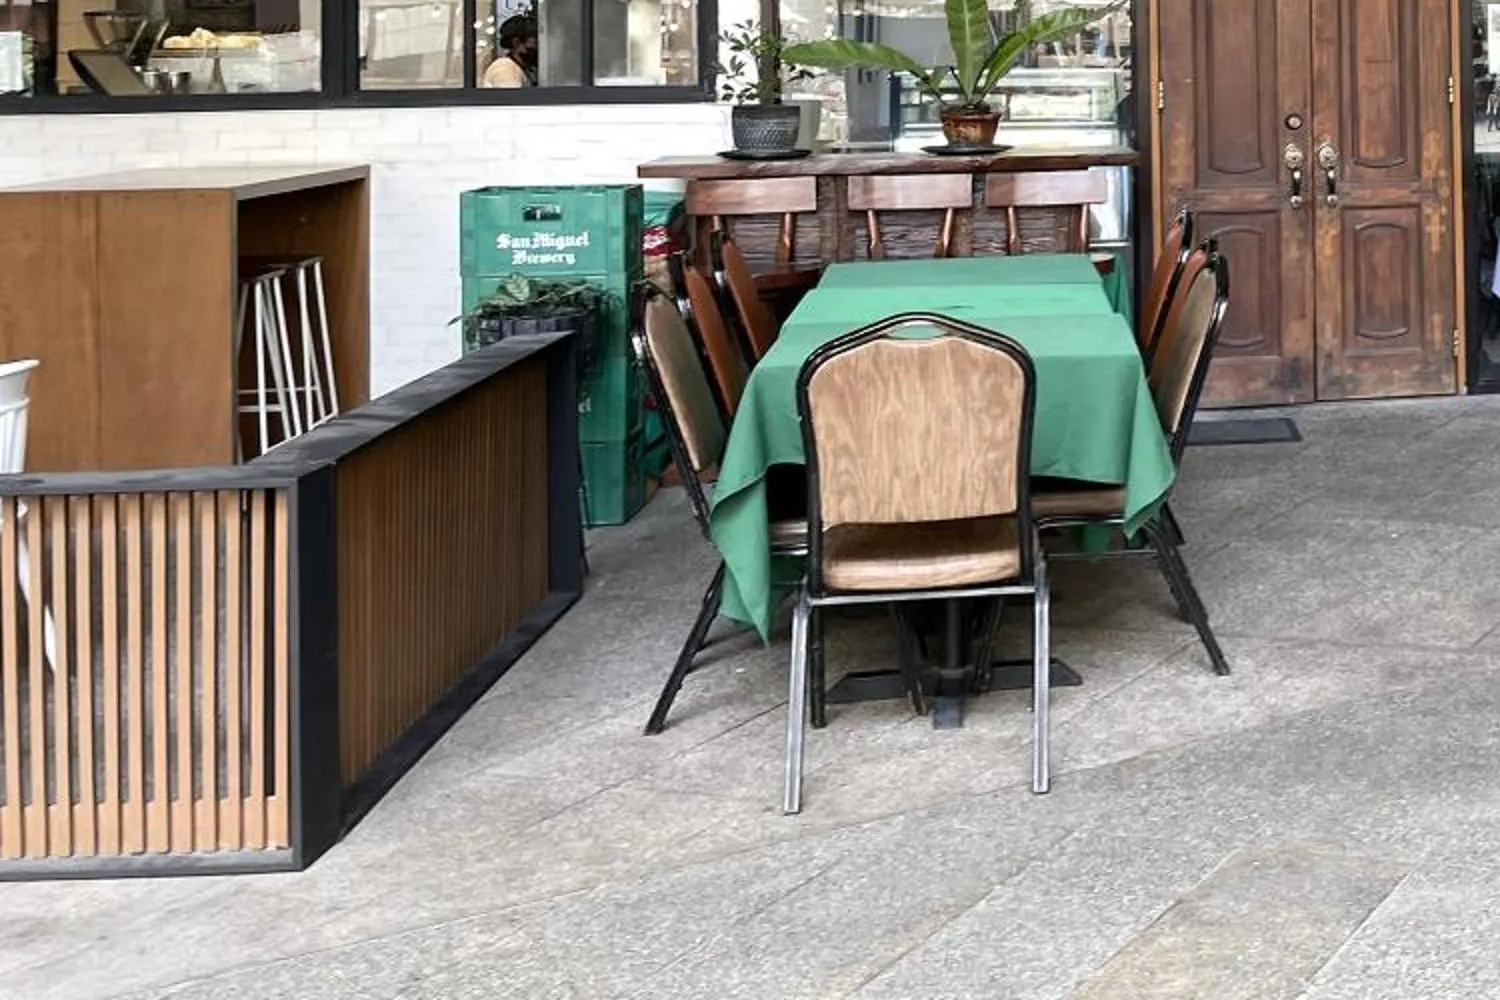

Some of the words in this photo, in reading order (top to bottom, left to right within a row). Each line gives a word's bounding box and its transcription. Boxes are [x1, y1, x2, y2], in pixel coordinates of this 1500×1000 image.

[496, 232, 531, 249] San
[531, 229, 592, 251] Miguel
[511, 249, 577, 265] Brewery
